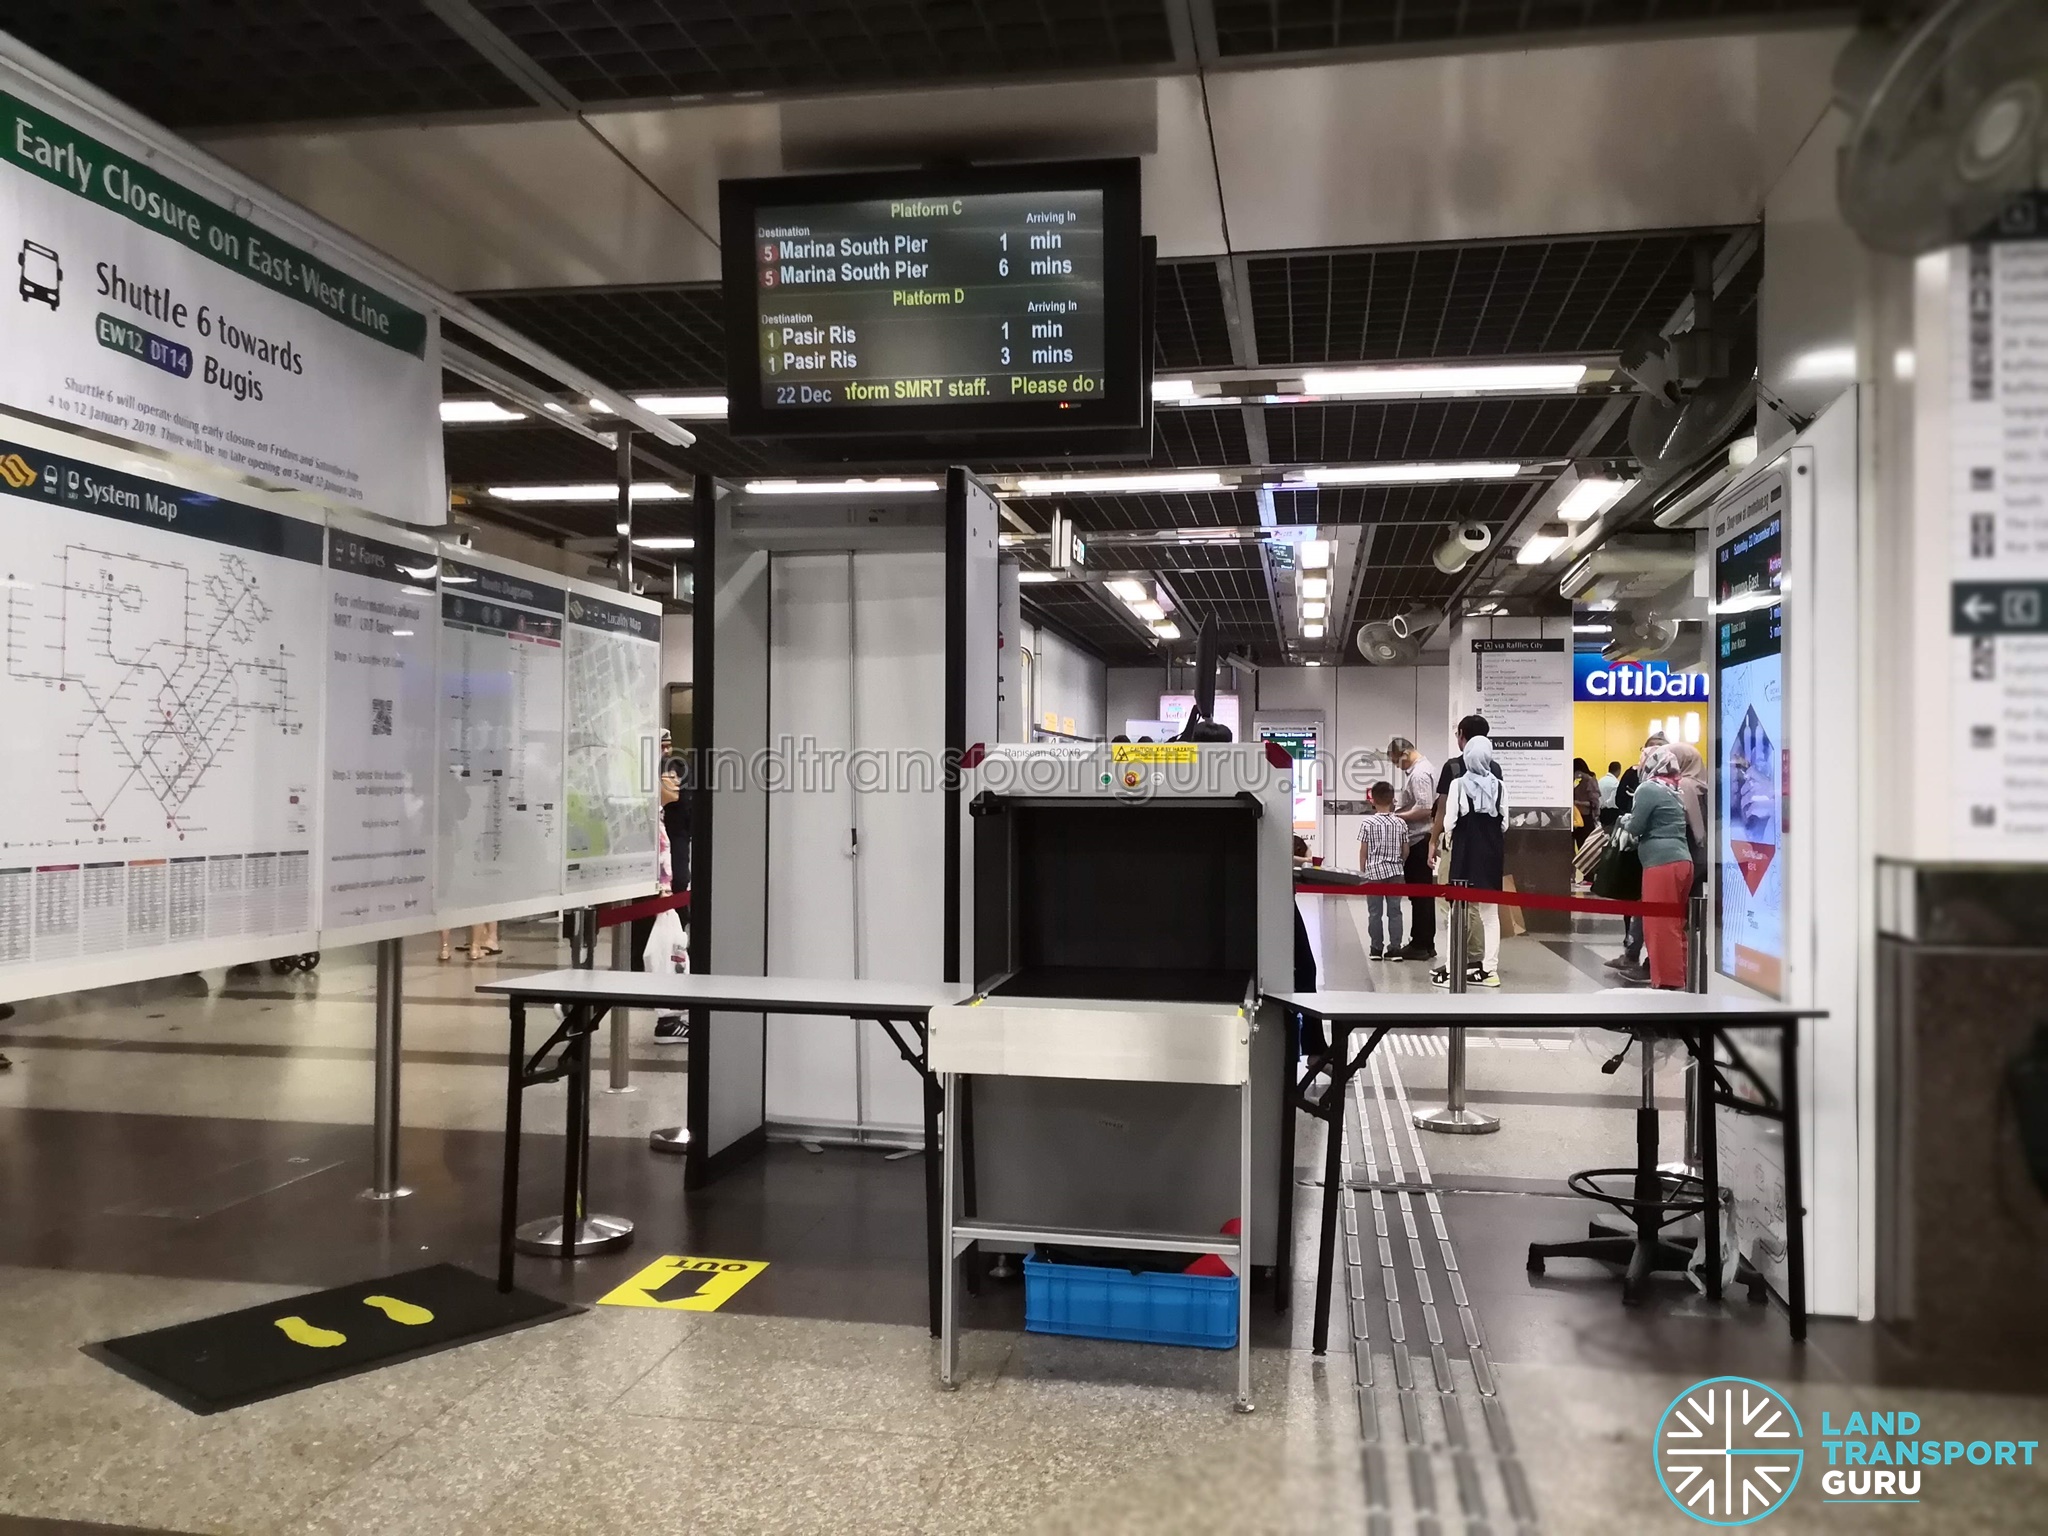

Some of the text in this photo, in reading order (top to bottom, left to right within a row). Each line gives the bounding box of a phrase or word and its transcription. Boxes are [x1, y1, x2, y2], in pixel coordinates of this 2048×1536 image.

[891, 201, 962, 218] Platform C
[16, 117, 390, 335] Early Closure on East-West Line
[758, 210, 1077, 238] Destination Arriving In
[779, 242, 835, 260] Marina
[840, 238, 889, 257] South
[895, 236, 928, 254] Pier
[999, 234, 1007, 251] 1
[1030, 231, 1062, 249] min
[781, 266, 836, 285] Marina
[841, 263, 890, 282] South
[895, 261, 928, 279] Pier
[999, 259, 1009, 276] 6
[1031, 257, 1072, 275] mins
[893, 289, 964, 307] Platform D
[97, 262, 303, 375] Shuttle 6 towards
[761, 300, 1078, 325] Destination Arriving In
[100, 319, 188, 372] EW12 DT14
[783, 327, 824, 346] Pasir
[830, 326, 856, 344] Ris
[1001, 322, 1008, 340] 1
[1032, 320, 1062, 338] min
[784, 352, 825, 371] Pasir
[831, 351, 857, 369] Ris
[1001, 348, 1010, 365] 3
[1032, 346, 1073, 364] mins
[204, 355, 263, 401] Bugis
[894, 380, 943, 399] SMRT
[948, 379, 990, 397] staff.
[1011, 376, 1067, 395] Please
[1073, 374, 1095, 392] do
[58, 398, 70, 411] to
[74, 402, 86, 416] 12
[777, 386, 832, 404] 22 Dec
[65, 377, 105, 400] Shuttle
[107, 390, 113, 402] 6
[117, 395, 136, 409] will
[202, 424, 224, 440] early
[226, 430, 256, 449] closure
[84, 477, 178, 522] System Map
[360, 547, 386, 568] Fares
[607, 612, 642, 632] Locality Map
[1005, 748, 1081, 759] Rapiscan 620XR
[1506, 740, 1533, 748] CityLink
[665, 1259, 749, 1272] OUT
